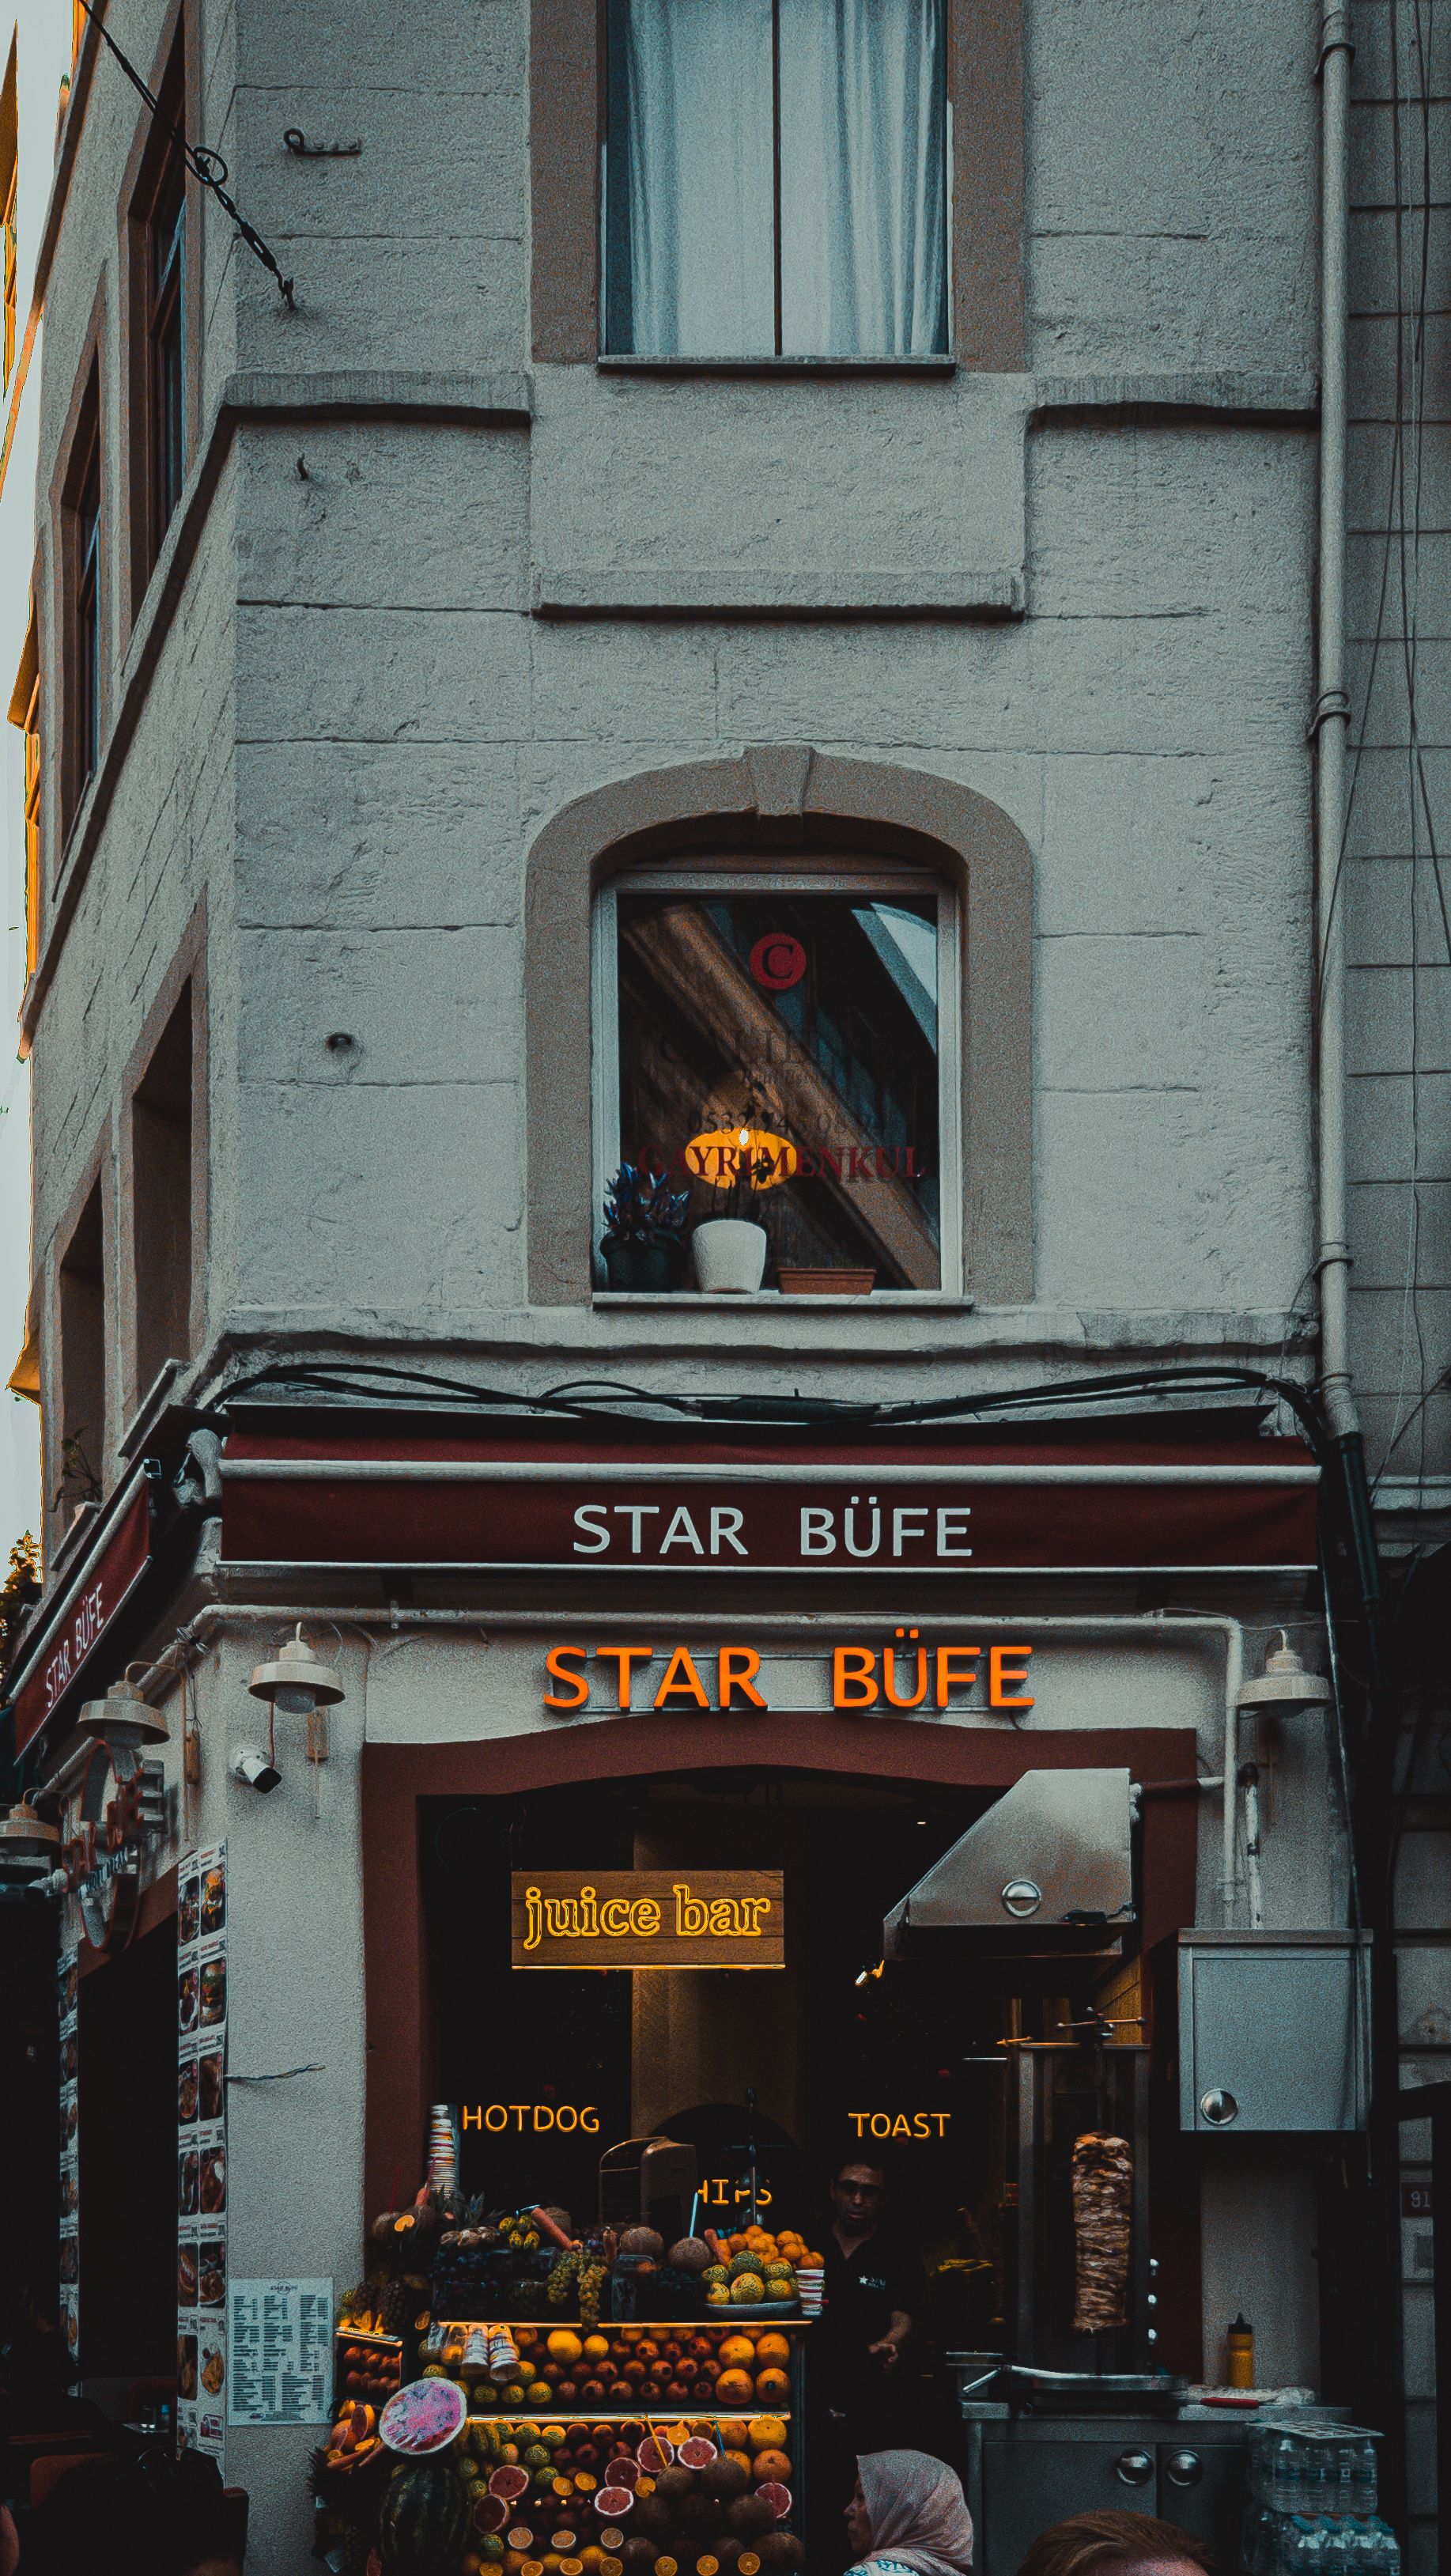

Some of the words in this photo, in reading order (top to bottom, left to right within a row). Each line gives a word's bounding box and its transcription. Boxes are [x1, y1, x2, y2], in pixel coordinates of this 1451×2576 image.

[760, 943, 794, 981] C
[573, 1504, 749, 1556] STAR
[800, 1496, 973, 1557] BÜFE
[46, 1640, 72, 1708] STAR
[75, 1581, 104, 1660] BÜFE
[543, 1646, 768, 1708] STAR
[833, 1628, 1036, 1708] BÜFE
[523, 1886, 661, 1950] juice
[673, 1883, 773, 1937] bar
[462, 2105, 600, 2133] HOTDOG
[848, 2113, 951, 2139] TOAST
